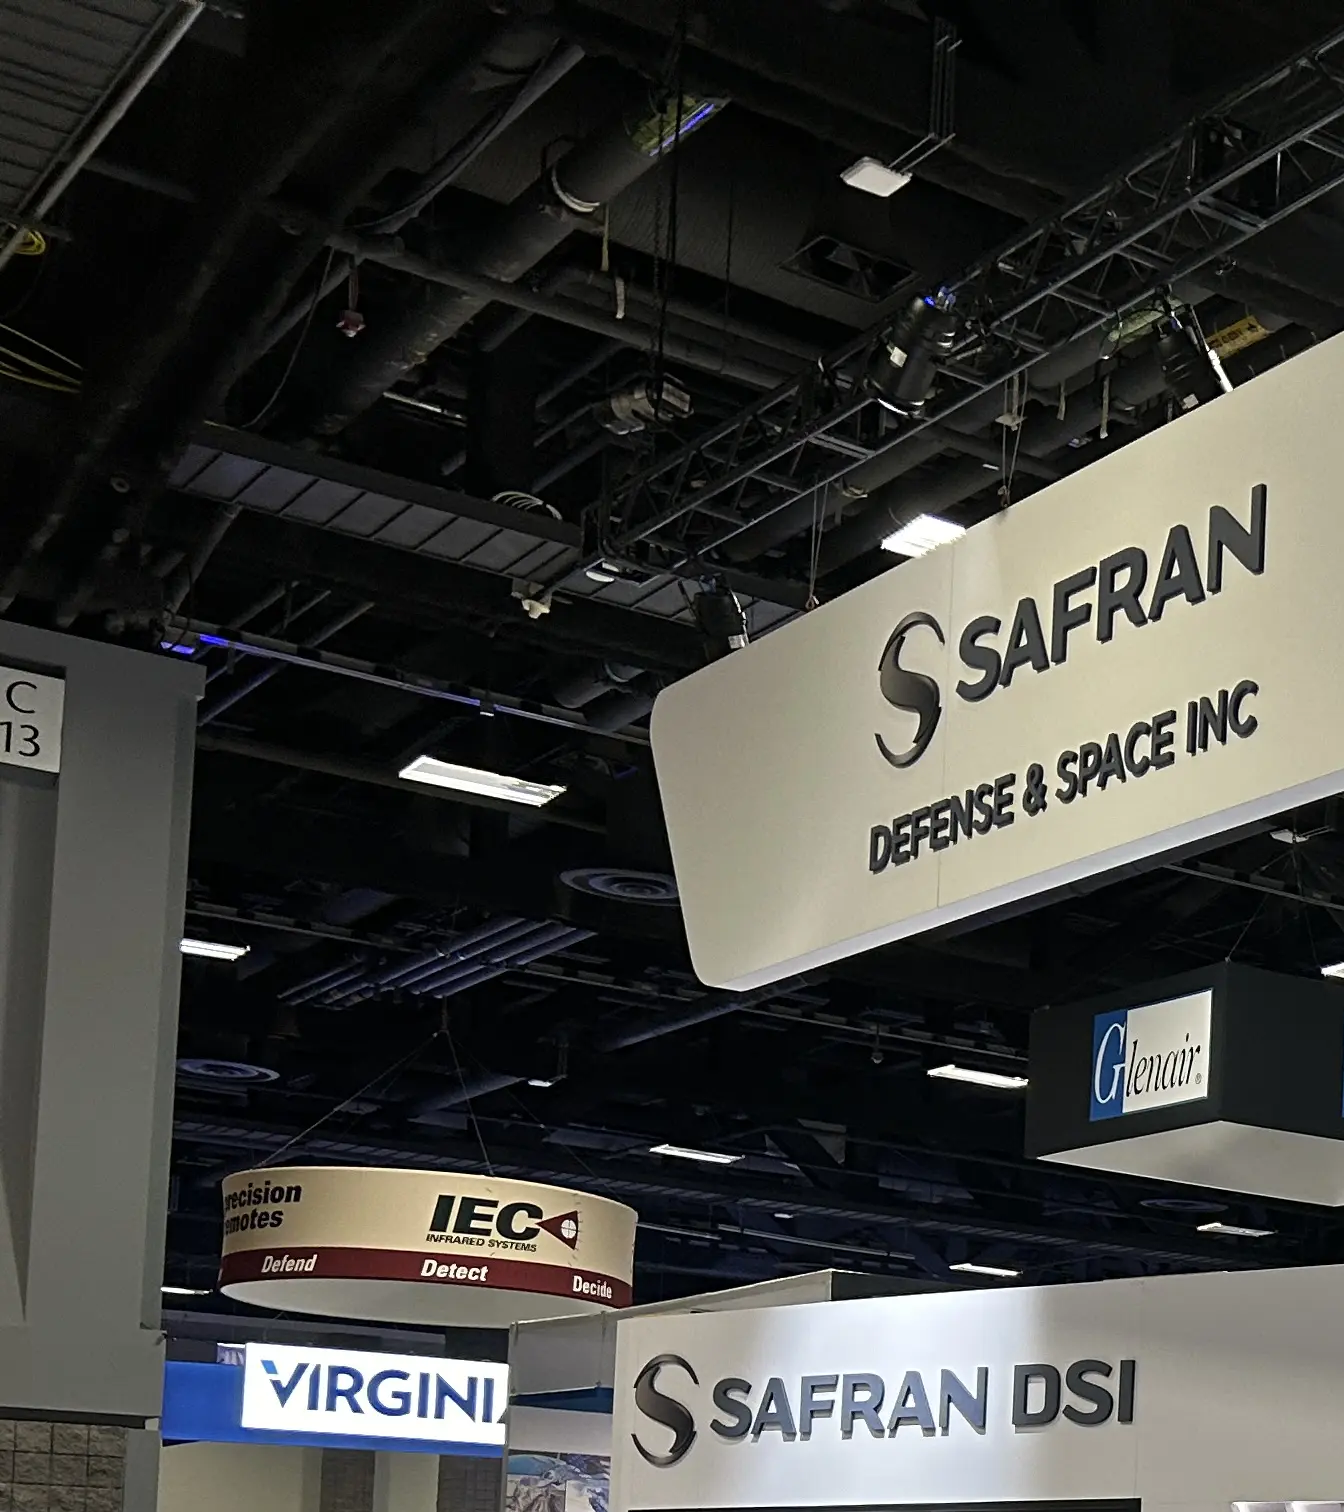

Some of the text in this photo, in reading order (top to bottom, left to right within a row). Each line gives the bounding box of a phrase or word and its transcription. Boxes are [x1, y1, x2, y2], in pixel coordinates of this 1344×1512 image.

[956, 483, 1267, 702] SAFRAN
[6, 681, 37, 714] C
[869, 680, 1259, 873] DEFENSE & SPACE INC
[429, 1194, 543, 1241] IEC
[426, 1233, 537, 1253] INFRARED SYSTEMS
[261, 1254, 613, 1300] Defend Detect Decide
[710, 1359, 1136, 1442] SAFRAN DSI
